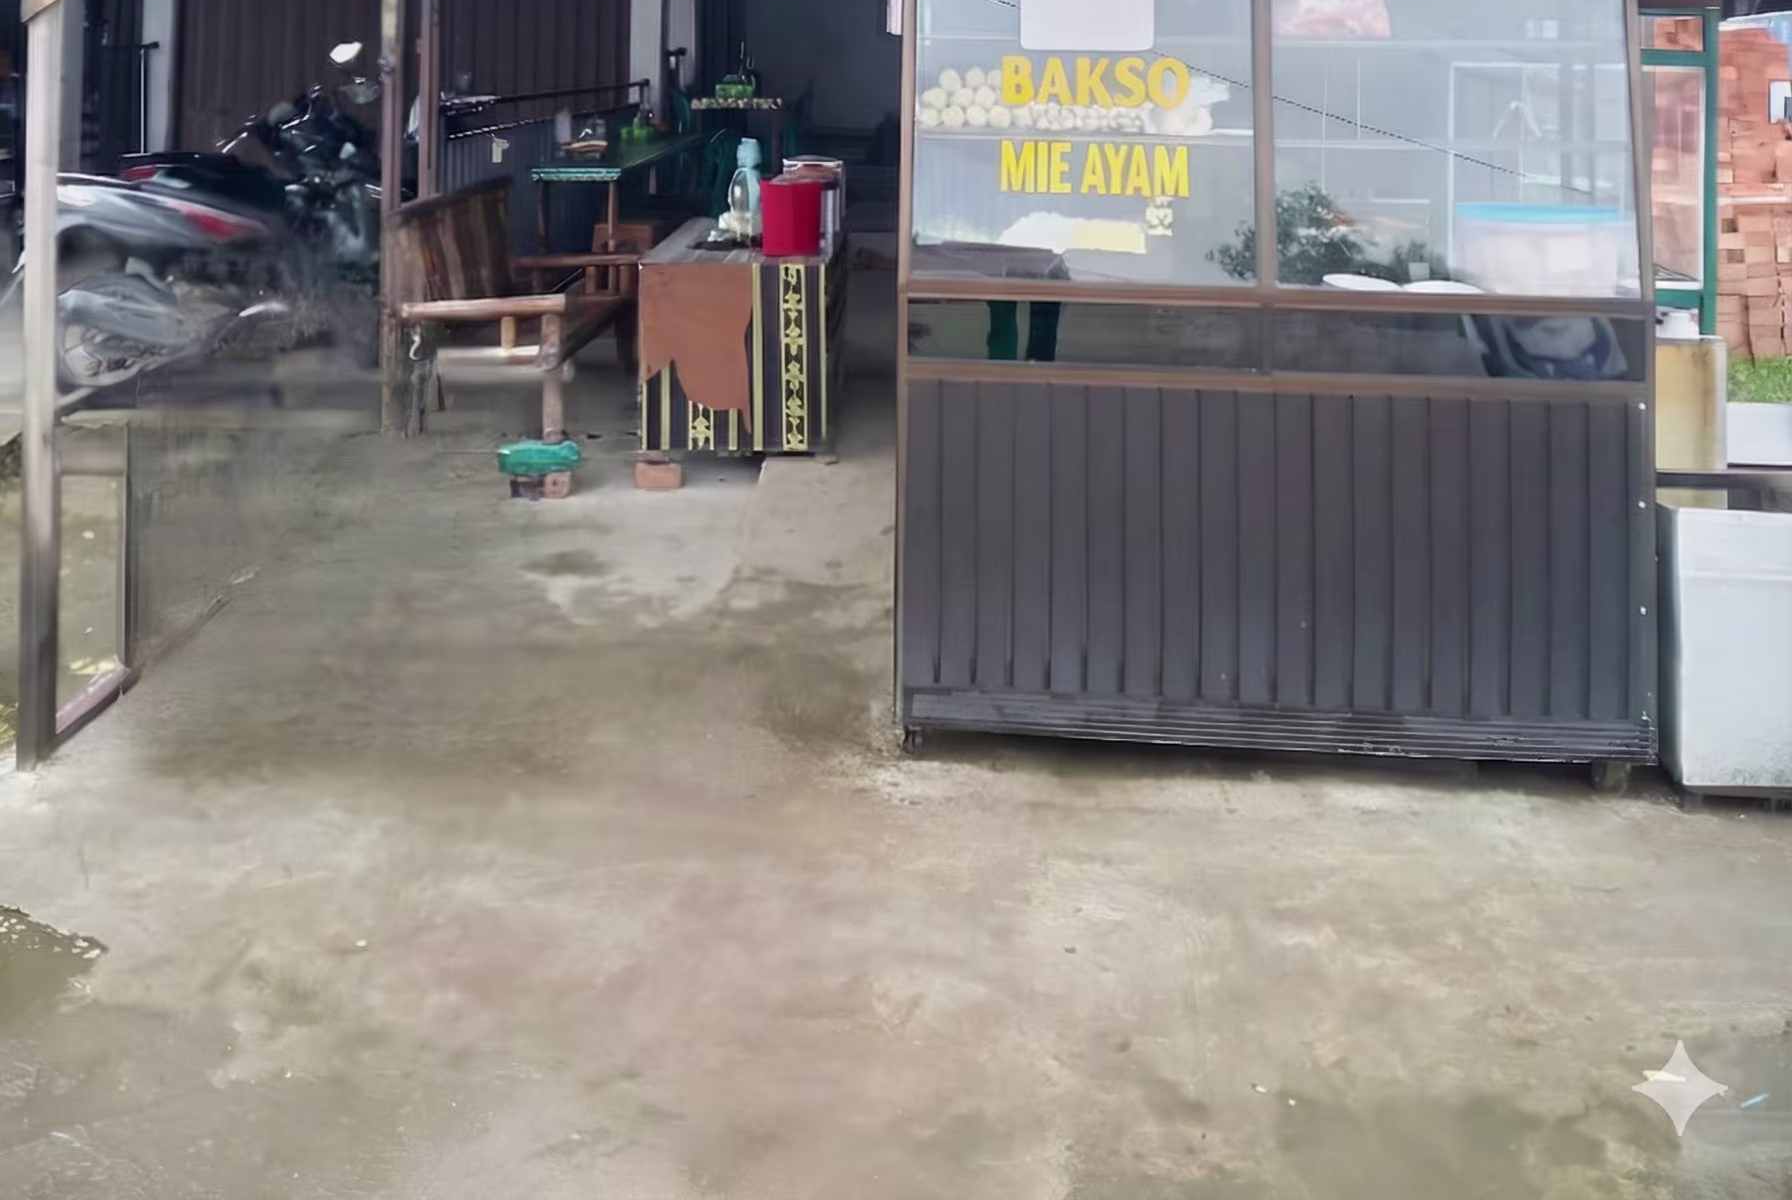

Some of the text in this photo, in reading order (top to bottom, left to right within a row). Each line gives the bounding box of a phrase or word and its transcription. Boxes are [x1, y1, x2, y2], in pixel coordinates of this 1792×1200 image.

[1002, 55, 1191, 110] BAKSO
[1000, 139, 1190, 198] MIE AYAM
